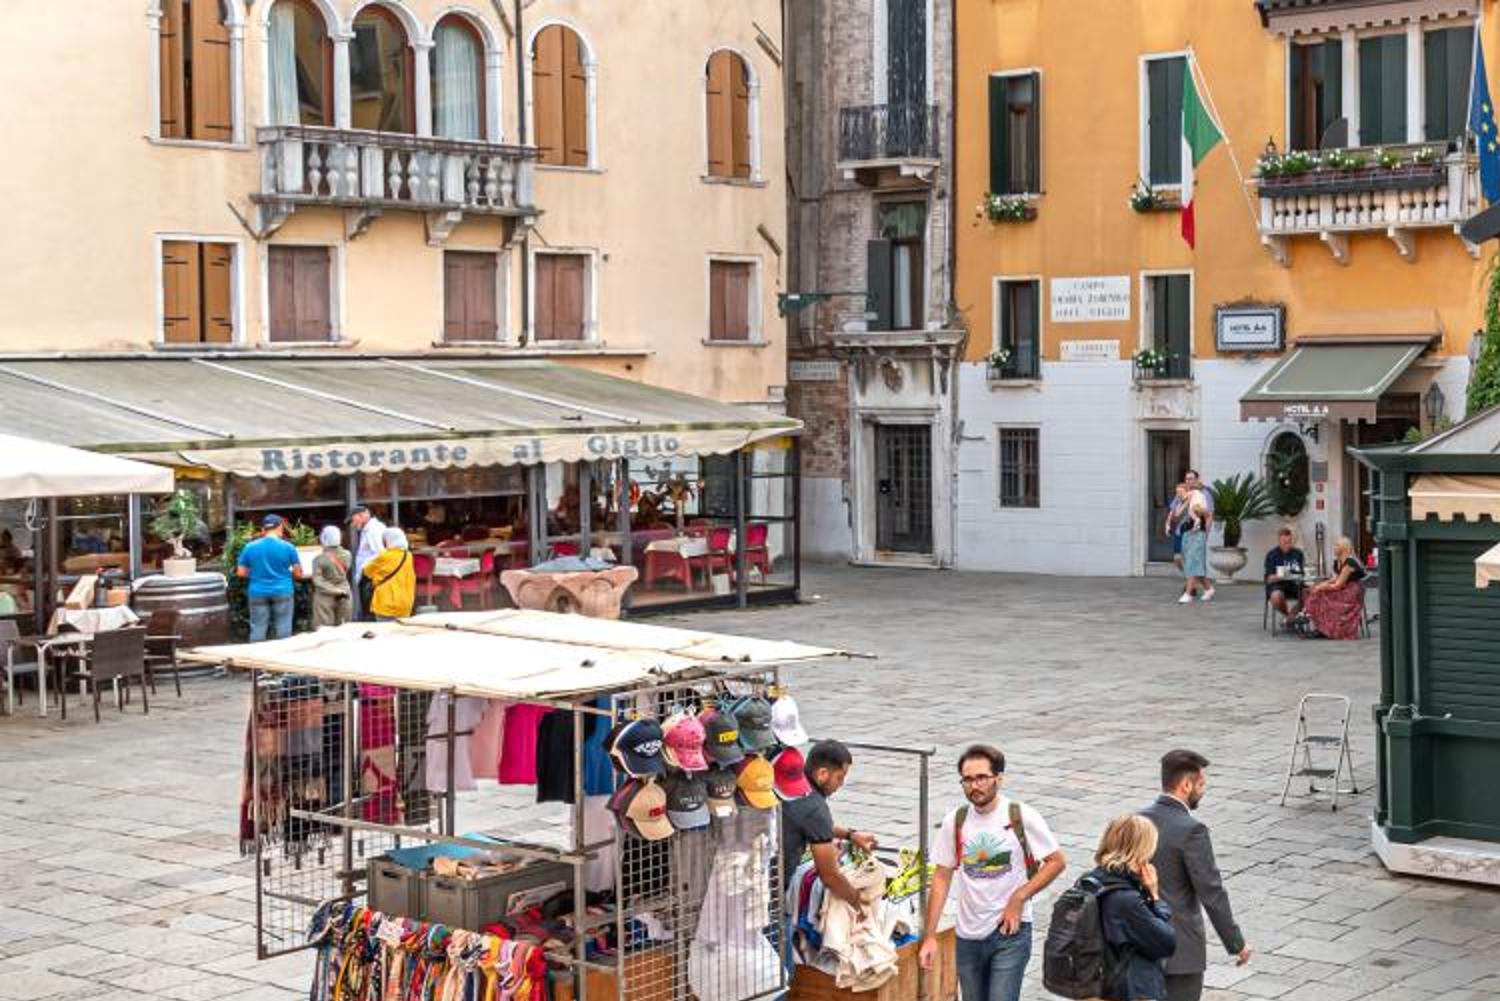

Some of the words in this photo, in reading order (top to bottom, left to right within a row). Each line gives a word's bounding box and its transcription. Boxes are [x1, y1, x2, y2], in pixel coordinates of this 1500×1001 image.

[1284, 405, 1309, 414] HOTEL
[261, 445, 467, 471] Ristorante
[512, 439, 543, 458] al
[587, 434, 679, 458] Giglio
